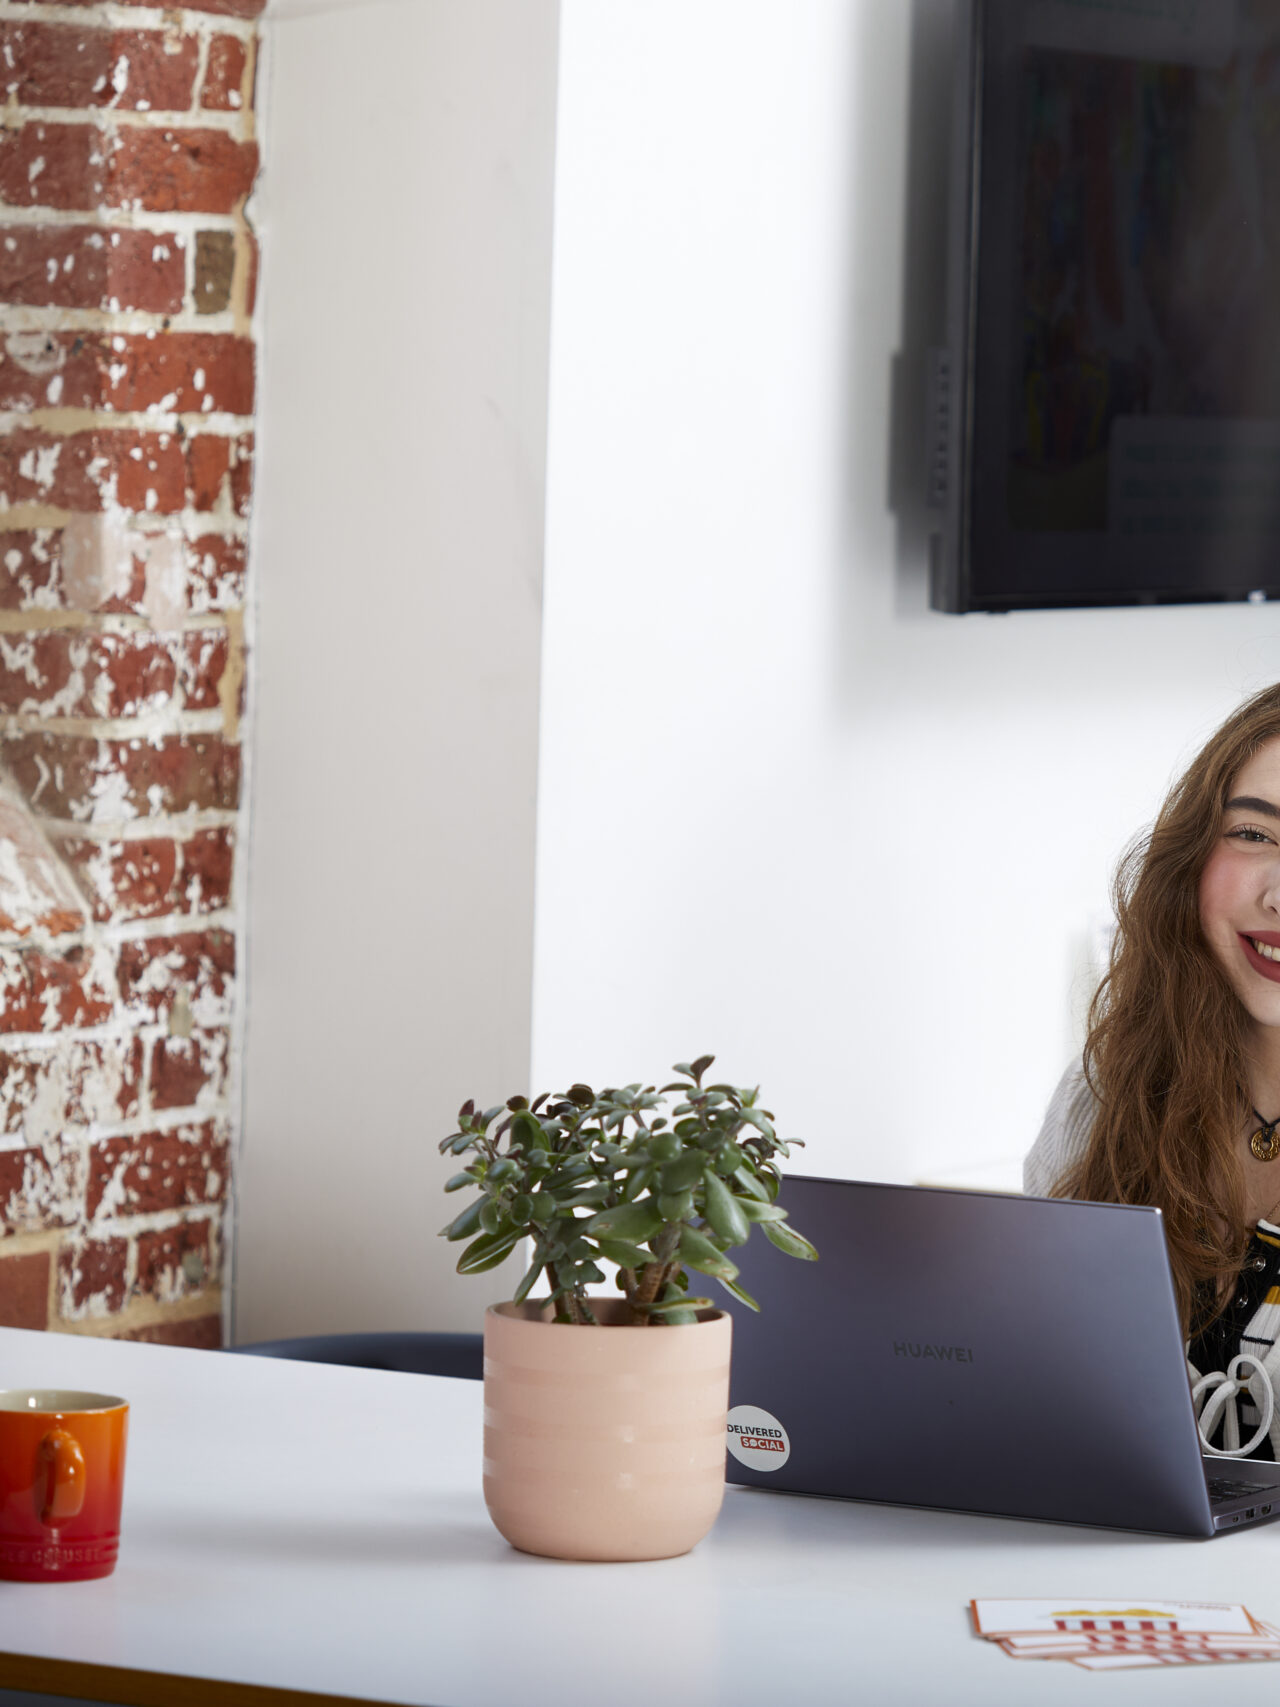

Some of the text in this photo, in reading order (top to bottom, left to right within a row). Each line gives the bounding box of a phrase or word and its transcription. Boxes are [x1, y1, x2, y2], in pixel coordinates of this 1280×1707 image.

[893, 1341, 973, 1363] HUAWEI
[727, 1424, 782, 1438] DELIVERED
[742, 1438, 784, 1451] SOCIAL
